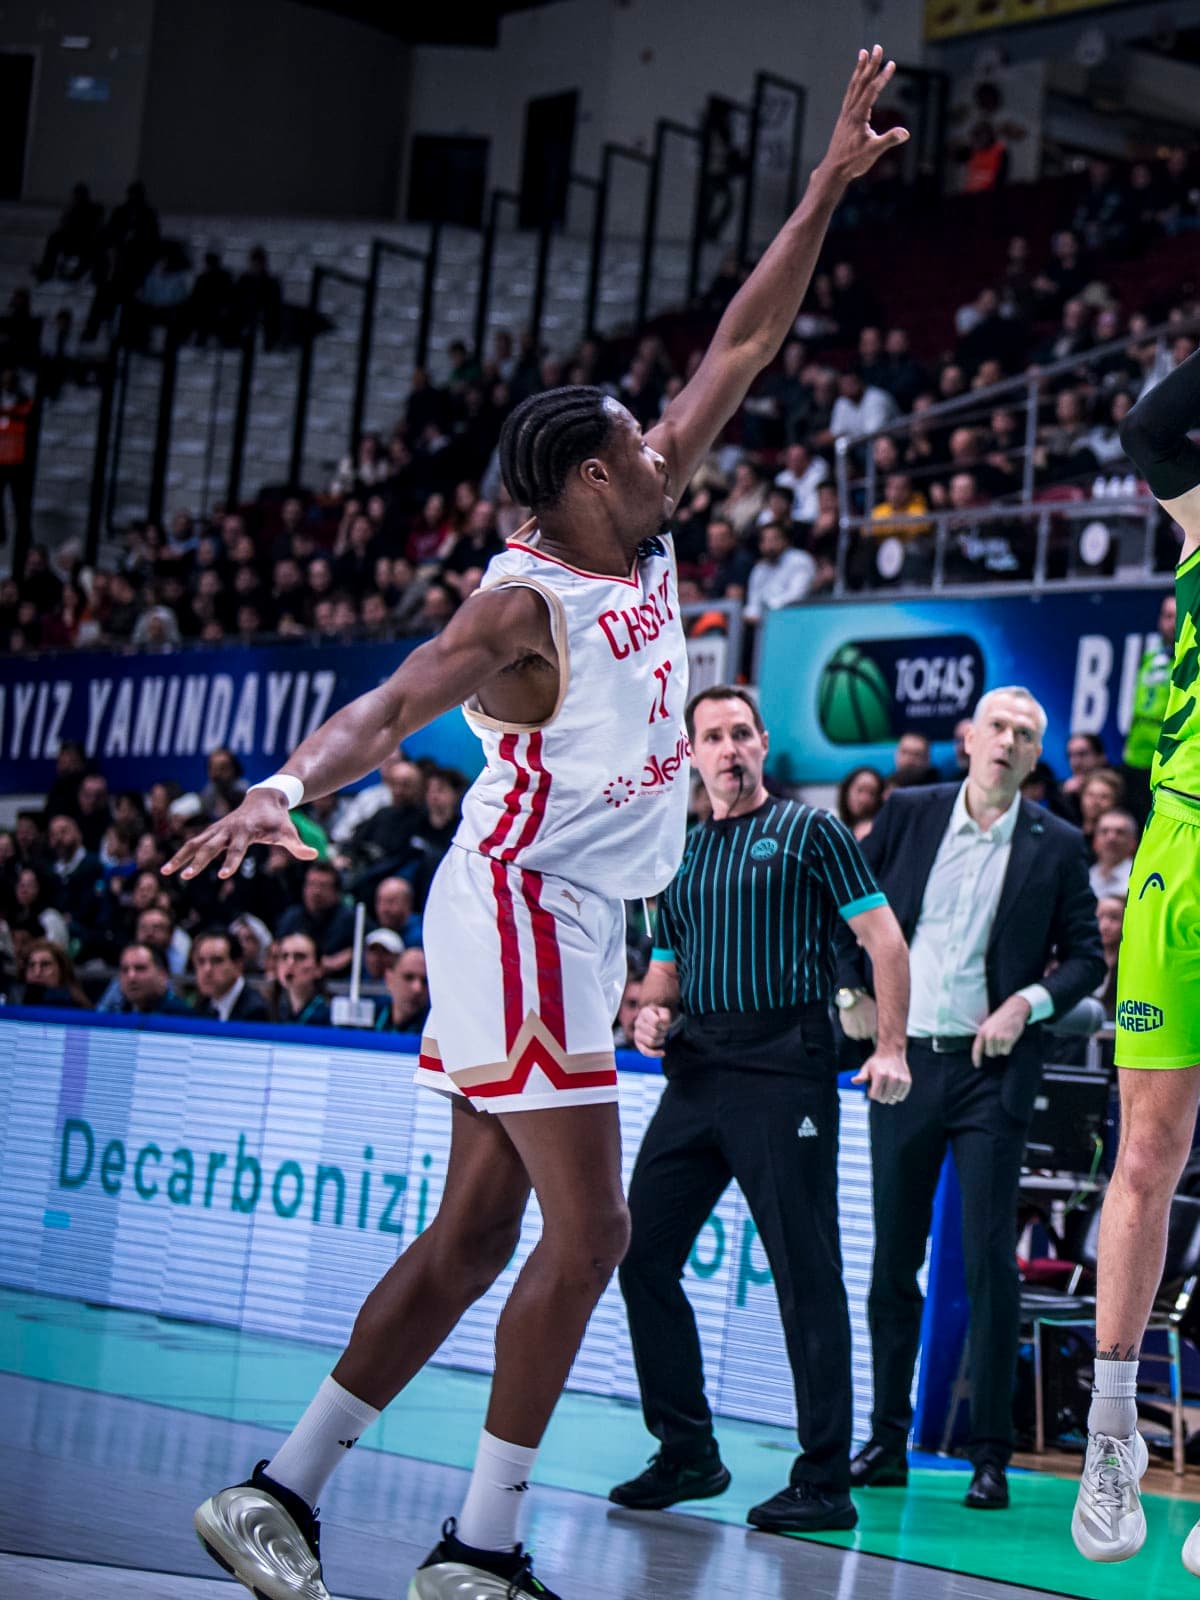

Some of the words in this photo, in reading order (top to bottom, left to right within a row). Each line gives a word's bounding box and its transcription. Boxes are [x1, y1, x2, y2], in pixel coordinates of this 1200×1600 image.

[0, 679, 74, 760] YIZ
[84, 669, 337, 759] YANINDAYIZ
[894, 653, 976, 712] TOFAŞ
[58, 1117, 429, 1236] Decarbonizi
